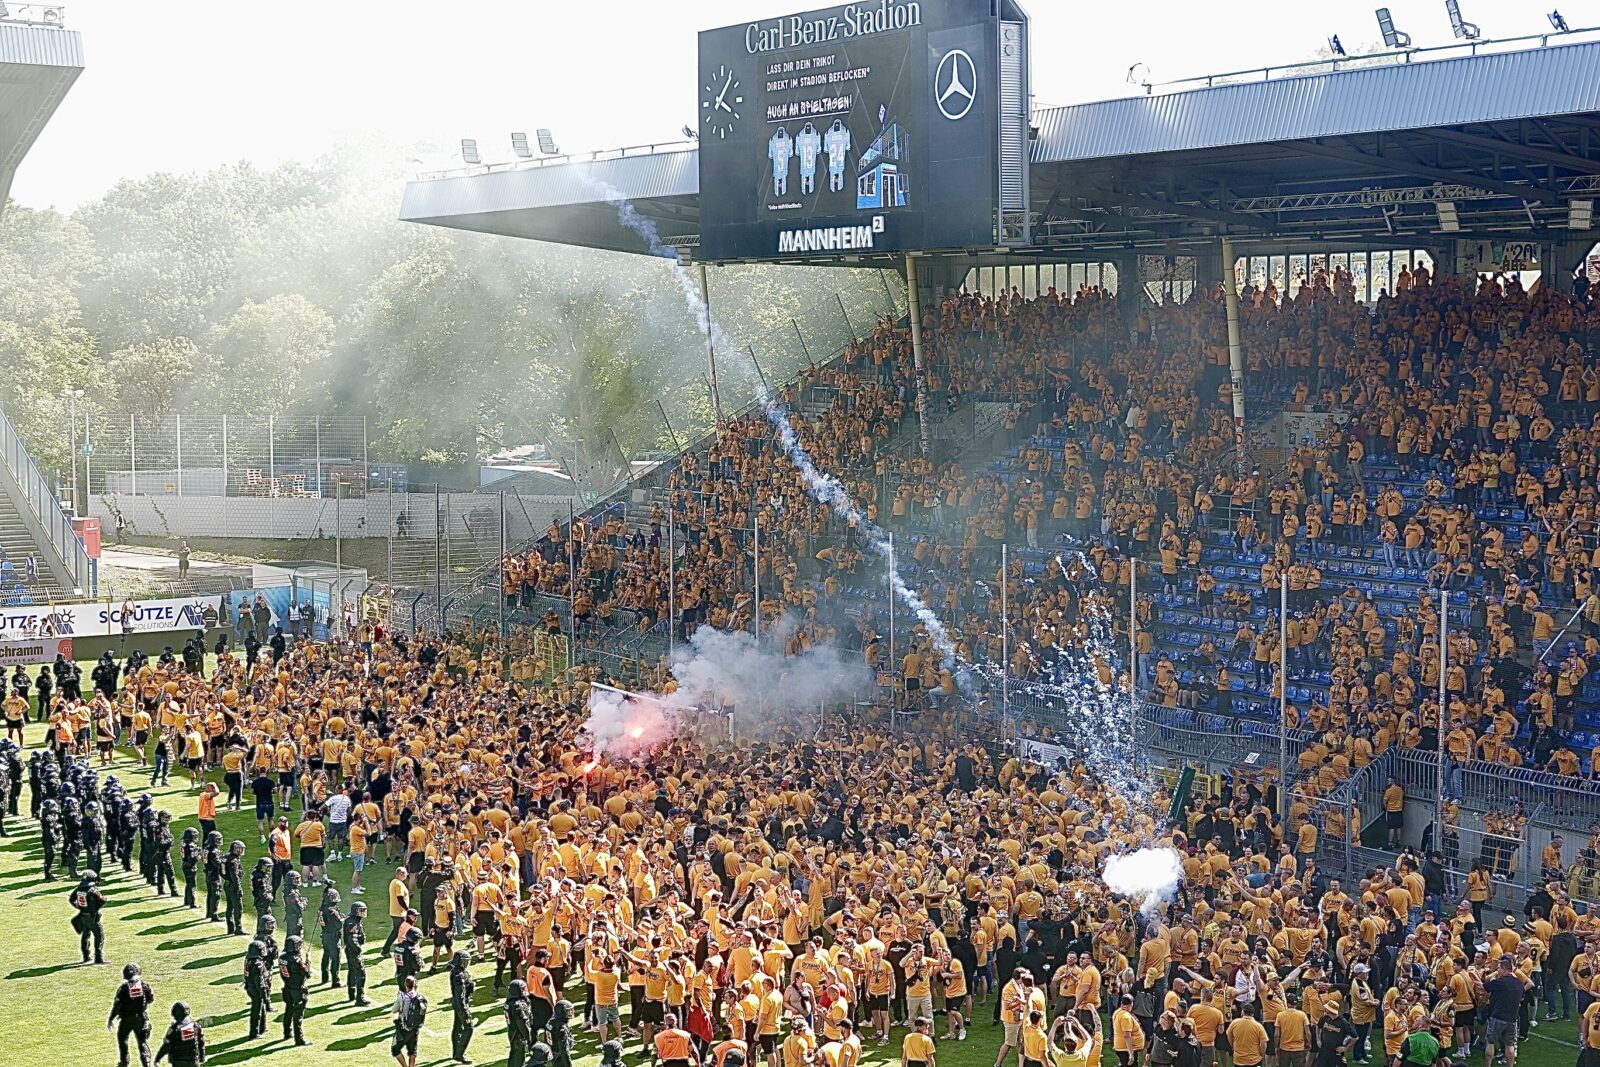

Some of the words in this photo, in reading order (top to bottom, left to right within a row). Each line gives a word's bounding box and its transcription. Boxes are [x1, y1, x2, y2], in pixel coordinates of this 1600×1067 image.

[745, 0, 922, 54] Carl-Benz-Stadion
[767, 64, 781, 74] LASS
[783, 62, 794, 72] DIR
[796, 59, 811, 70] DEIN
[813, 55, 835, 68] TRIKOT
[767, 80, 788, 91] DIREKT
[790, 78, 799, 88] IM
[800, 74, 827, 87] STADION
[778, 225, 873, 252] MANNHEIM
[99, 606, 174, 624] SCÜTZE
